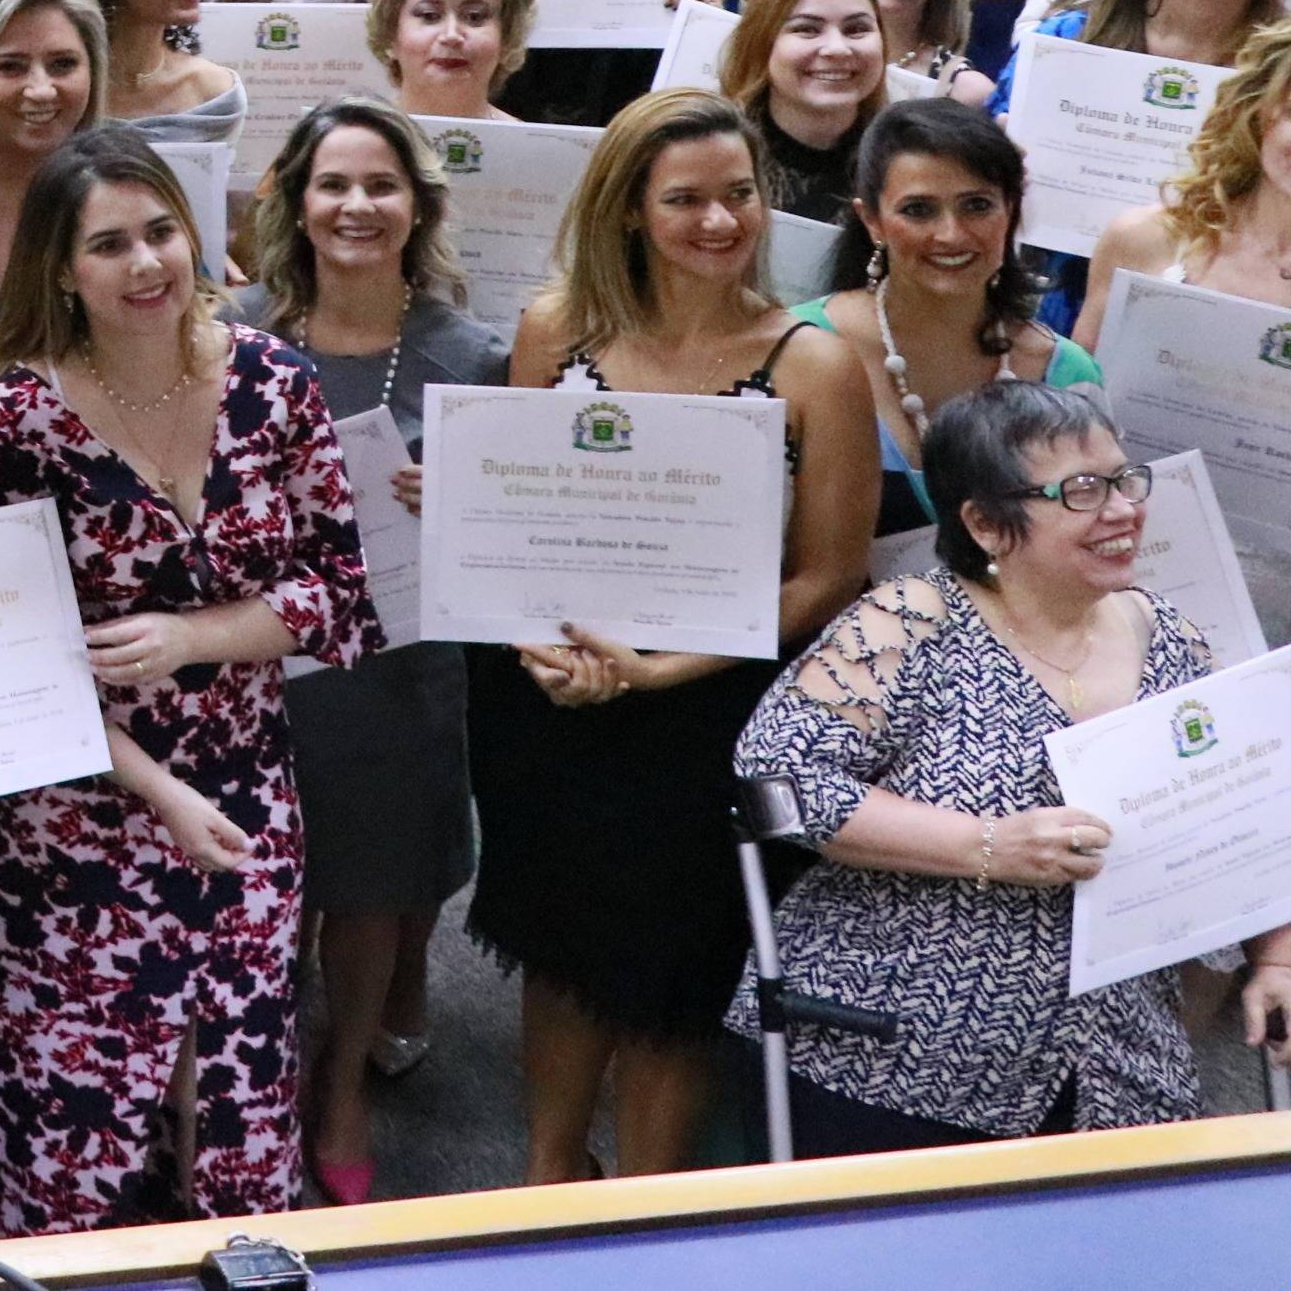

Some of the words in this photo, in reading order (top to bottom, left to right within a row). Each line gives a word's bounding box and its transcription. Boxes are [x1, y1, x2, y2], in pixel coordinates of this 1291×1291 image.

[1058, 98, 1119, 122] Diploma
[1122, 110, 1141, 126] de
[1145, 114, 1194, 135] Honra
[1075, 121, 1120, 140] Câmara
[480, 458, 550, 481] Diploma
[555, 462, 574, 480] de
[579, 463, 633, 482] Honra
[638, 471, 659, 484] ao
[663, 467, 722, 486] Mérito
[503, 482, 554, 499] Câmara
[557, 485, 620, 505] Municipal
[626, 488, 641, 503] de
[621, 537, 634, 551] de
[1119, 786, 1169, 816] Diploma
[1170, 777, 1186, 795] de
[1189, 764, 1225, 788] Honra
[1228, 757, 1243, 772] ao
[1245, 738, 1283, 766] Mérito
